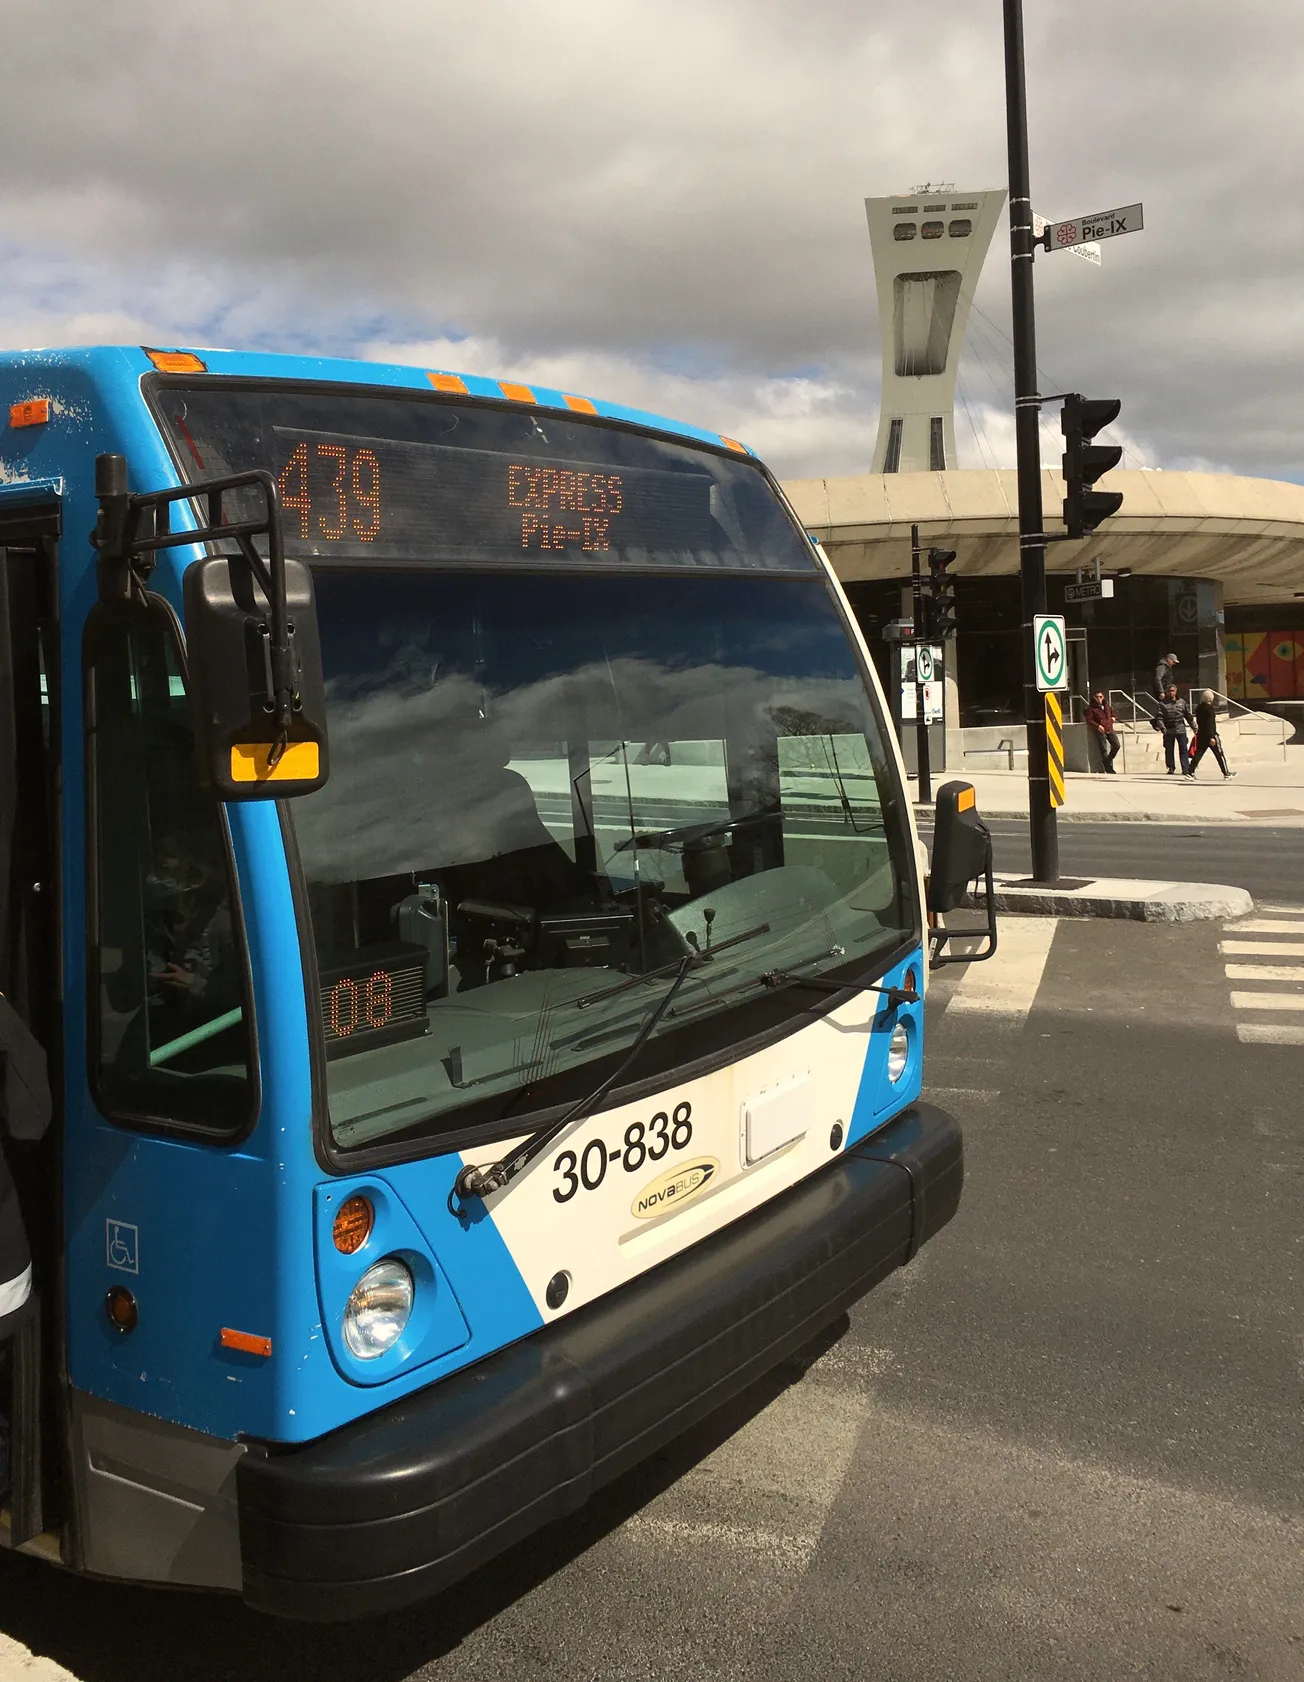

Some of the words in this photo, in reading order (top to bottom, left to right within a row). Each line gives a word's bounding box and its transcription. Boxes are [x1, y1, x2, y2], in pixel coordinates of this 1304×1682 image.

[1081, 213, 1115, 226] Boulevard
[1082, 217, 1128, 240] Pie-IX
[278, 441, 381, 542] 439
[508, 464, 623, 514] EXPRESS
[521, 512, 610, 551] Pie-IX
[330, 970, 393, 1037] 08
[552, 1100, 693, 1204] 30-838
